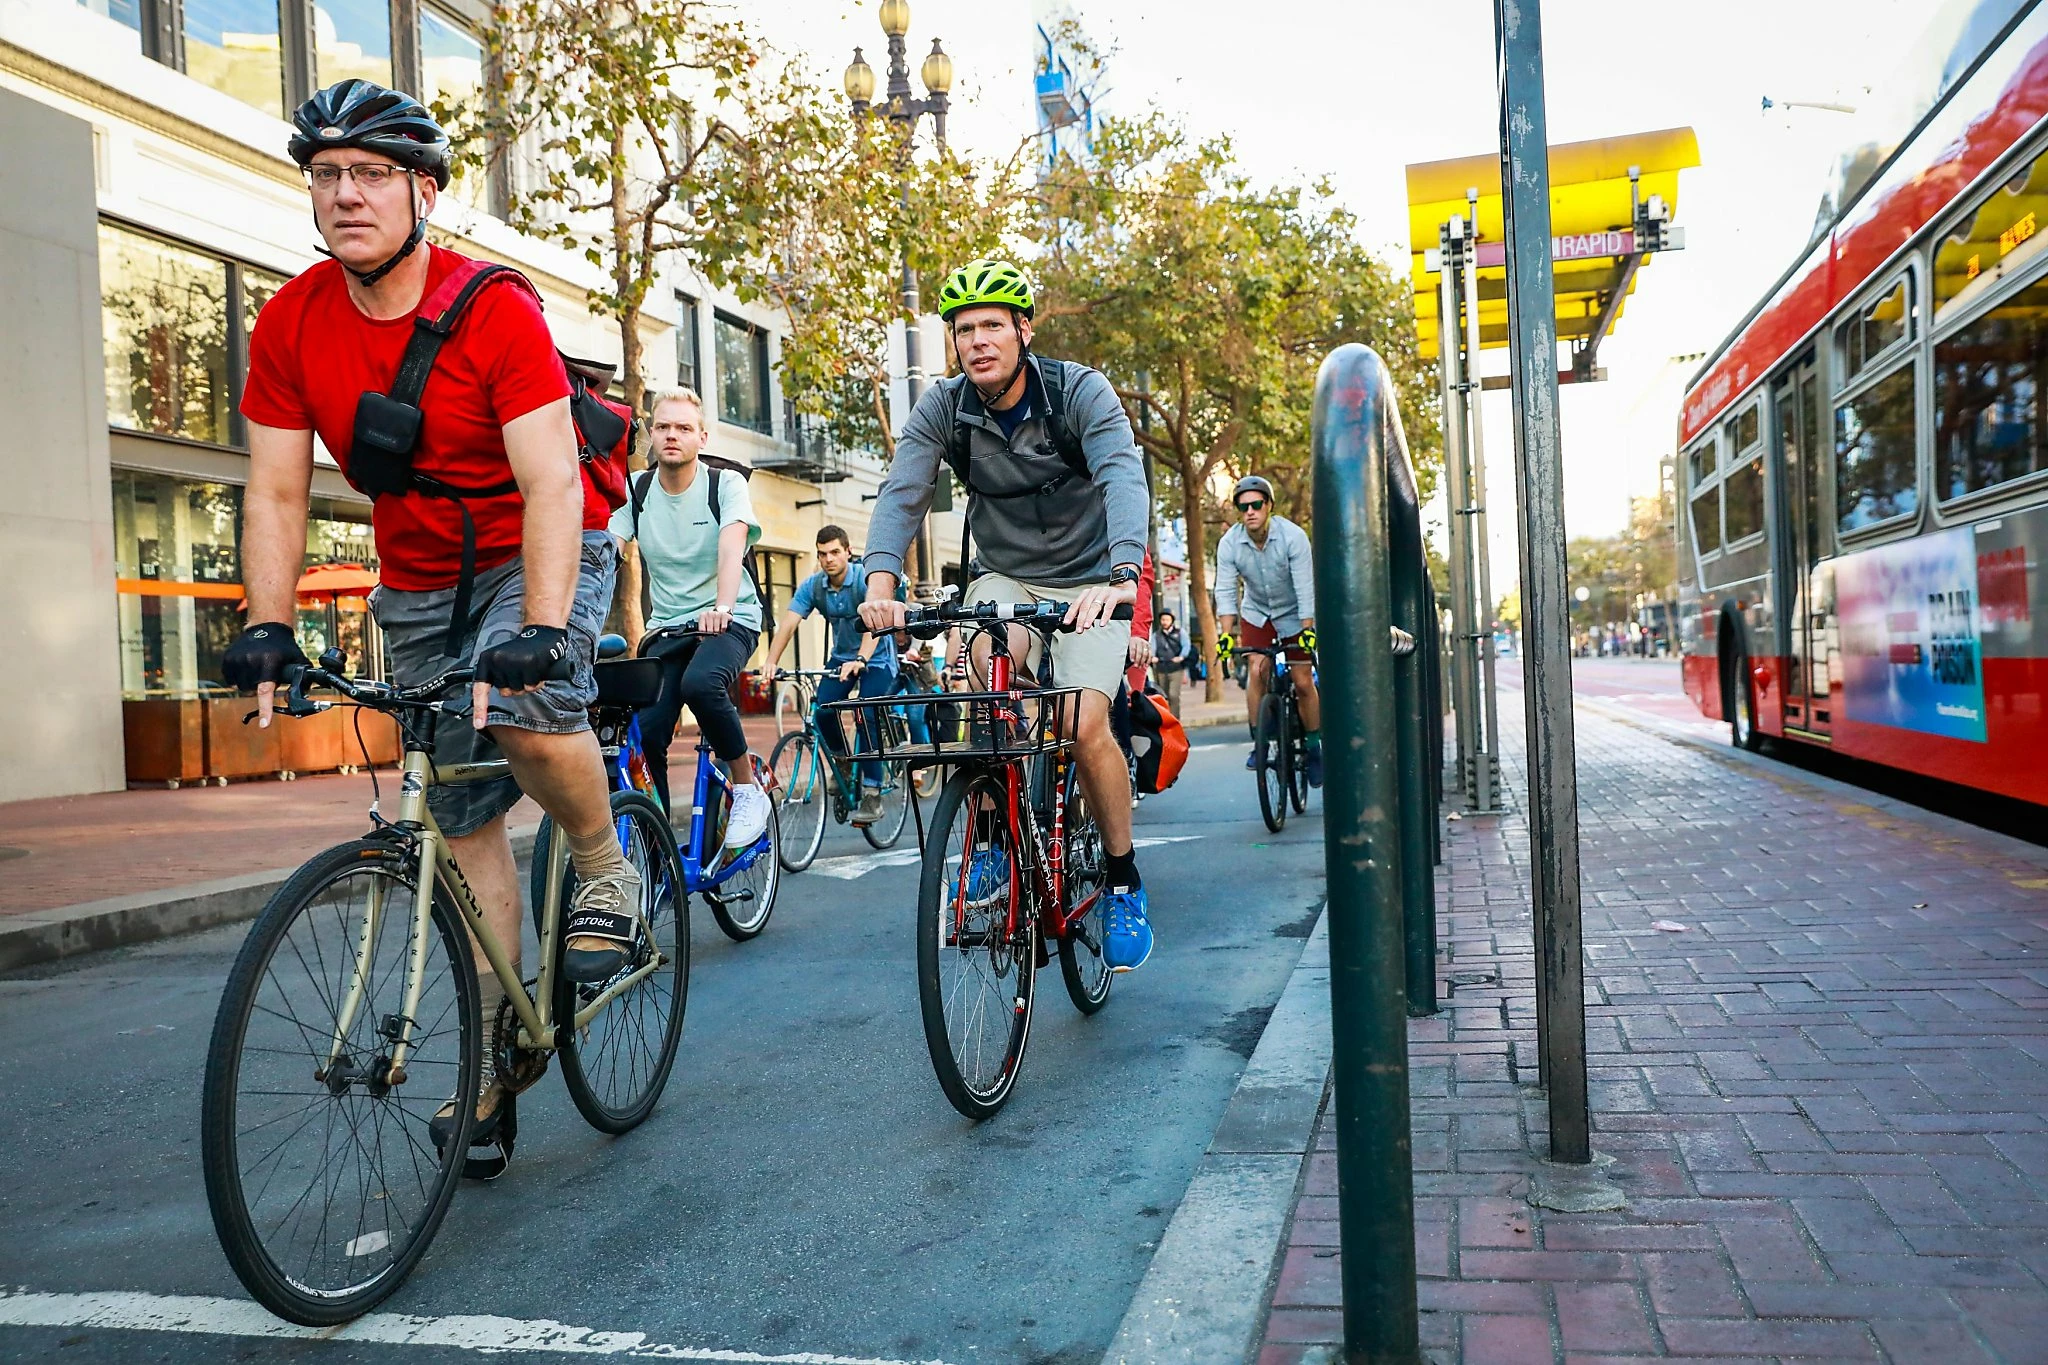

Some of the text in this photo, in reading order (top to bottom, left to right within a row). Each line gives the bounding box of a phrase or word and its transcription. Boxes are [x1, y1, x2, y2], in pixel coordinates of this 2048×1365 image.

[1562, 232, 1623, 258] RAPID
[350, 916, 369, 991] SURLY
[408, 915, 420, 989] SURLY
